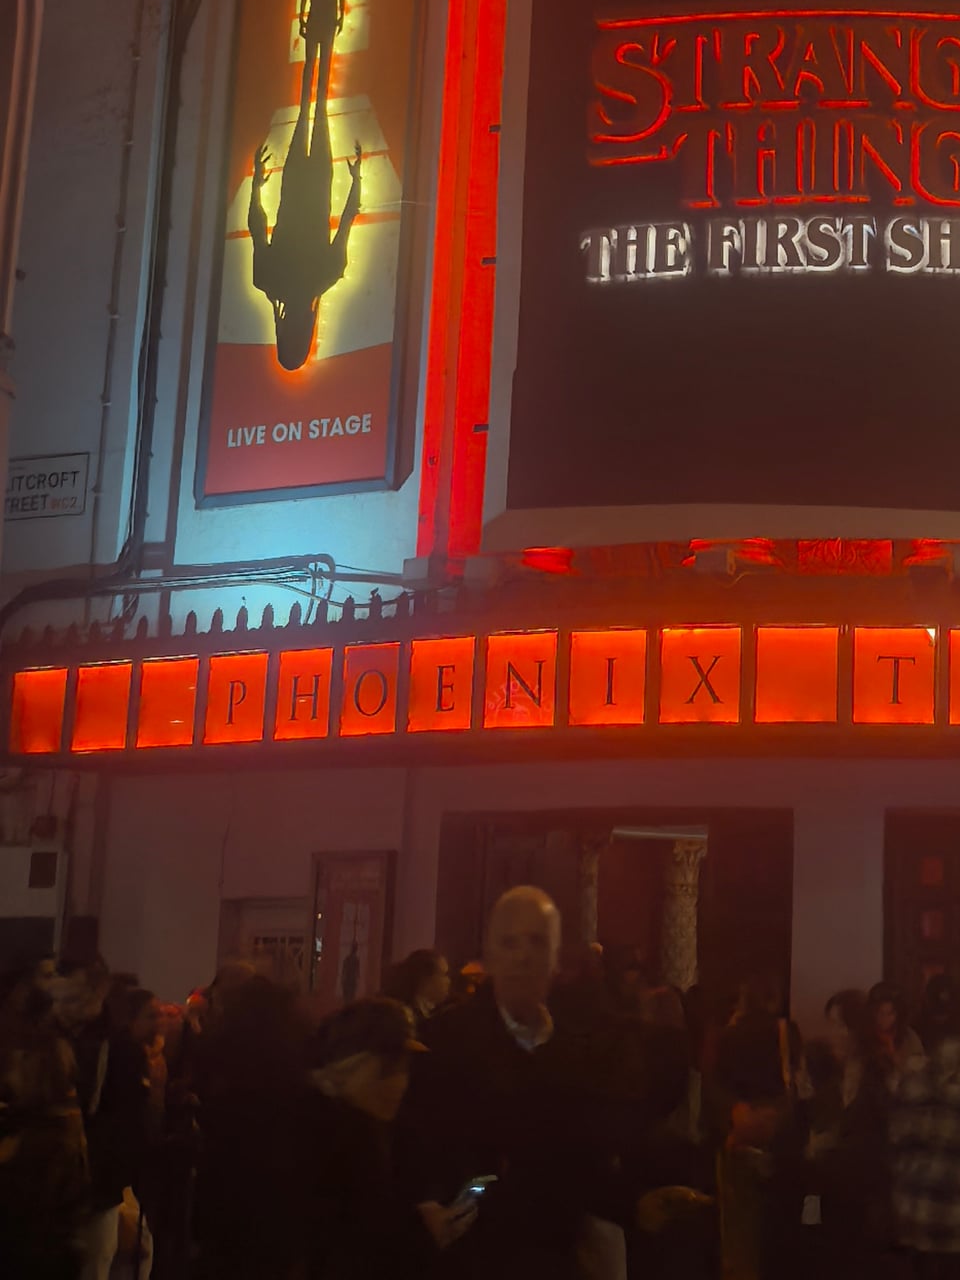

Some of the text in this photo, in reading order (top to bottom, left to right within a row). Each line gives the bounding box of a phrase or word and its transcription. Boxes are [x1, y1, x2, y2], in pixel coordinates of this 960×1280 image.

[580, 222, 693, 283] THE
[709, 216, 876, 273] FIRST
[227, 413, 372, 449] LIVE ON STAGE
[6, 470, 80, 493] ITCROFT
[226, 655, 724, 726] PHOENIX
